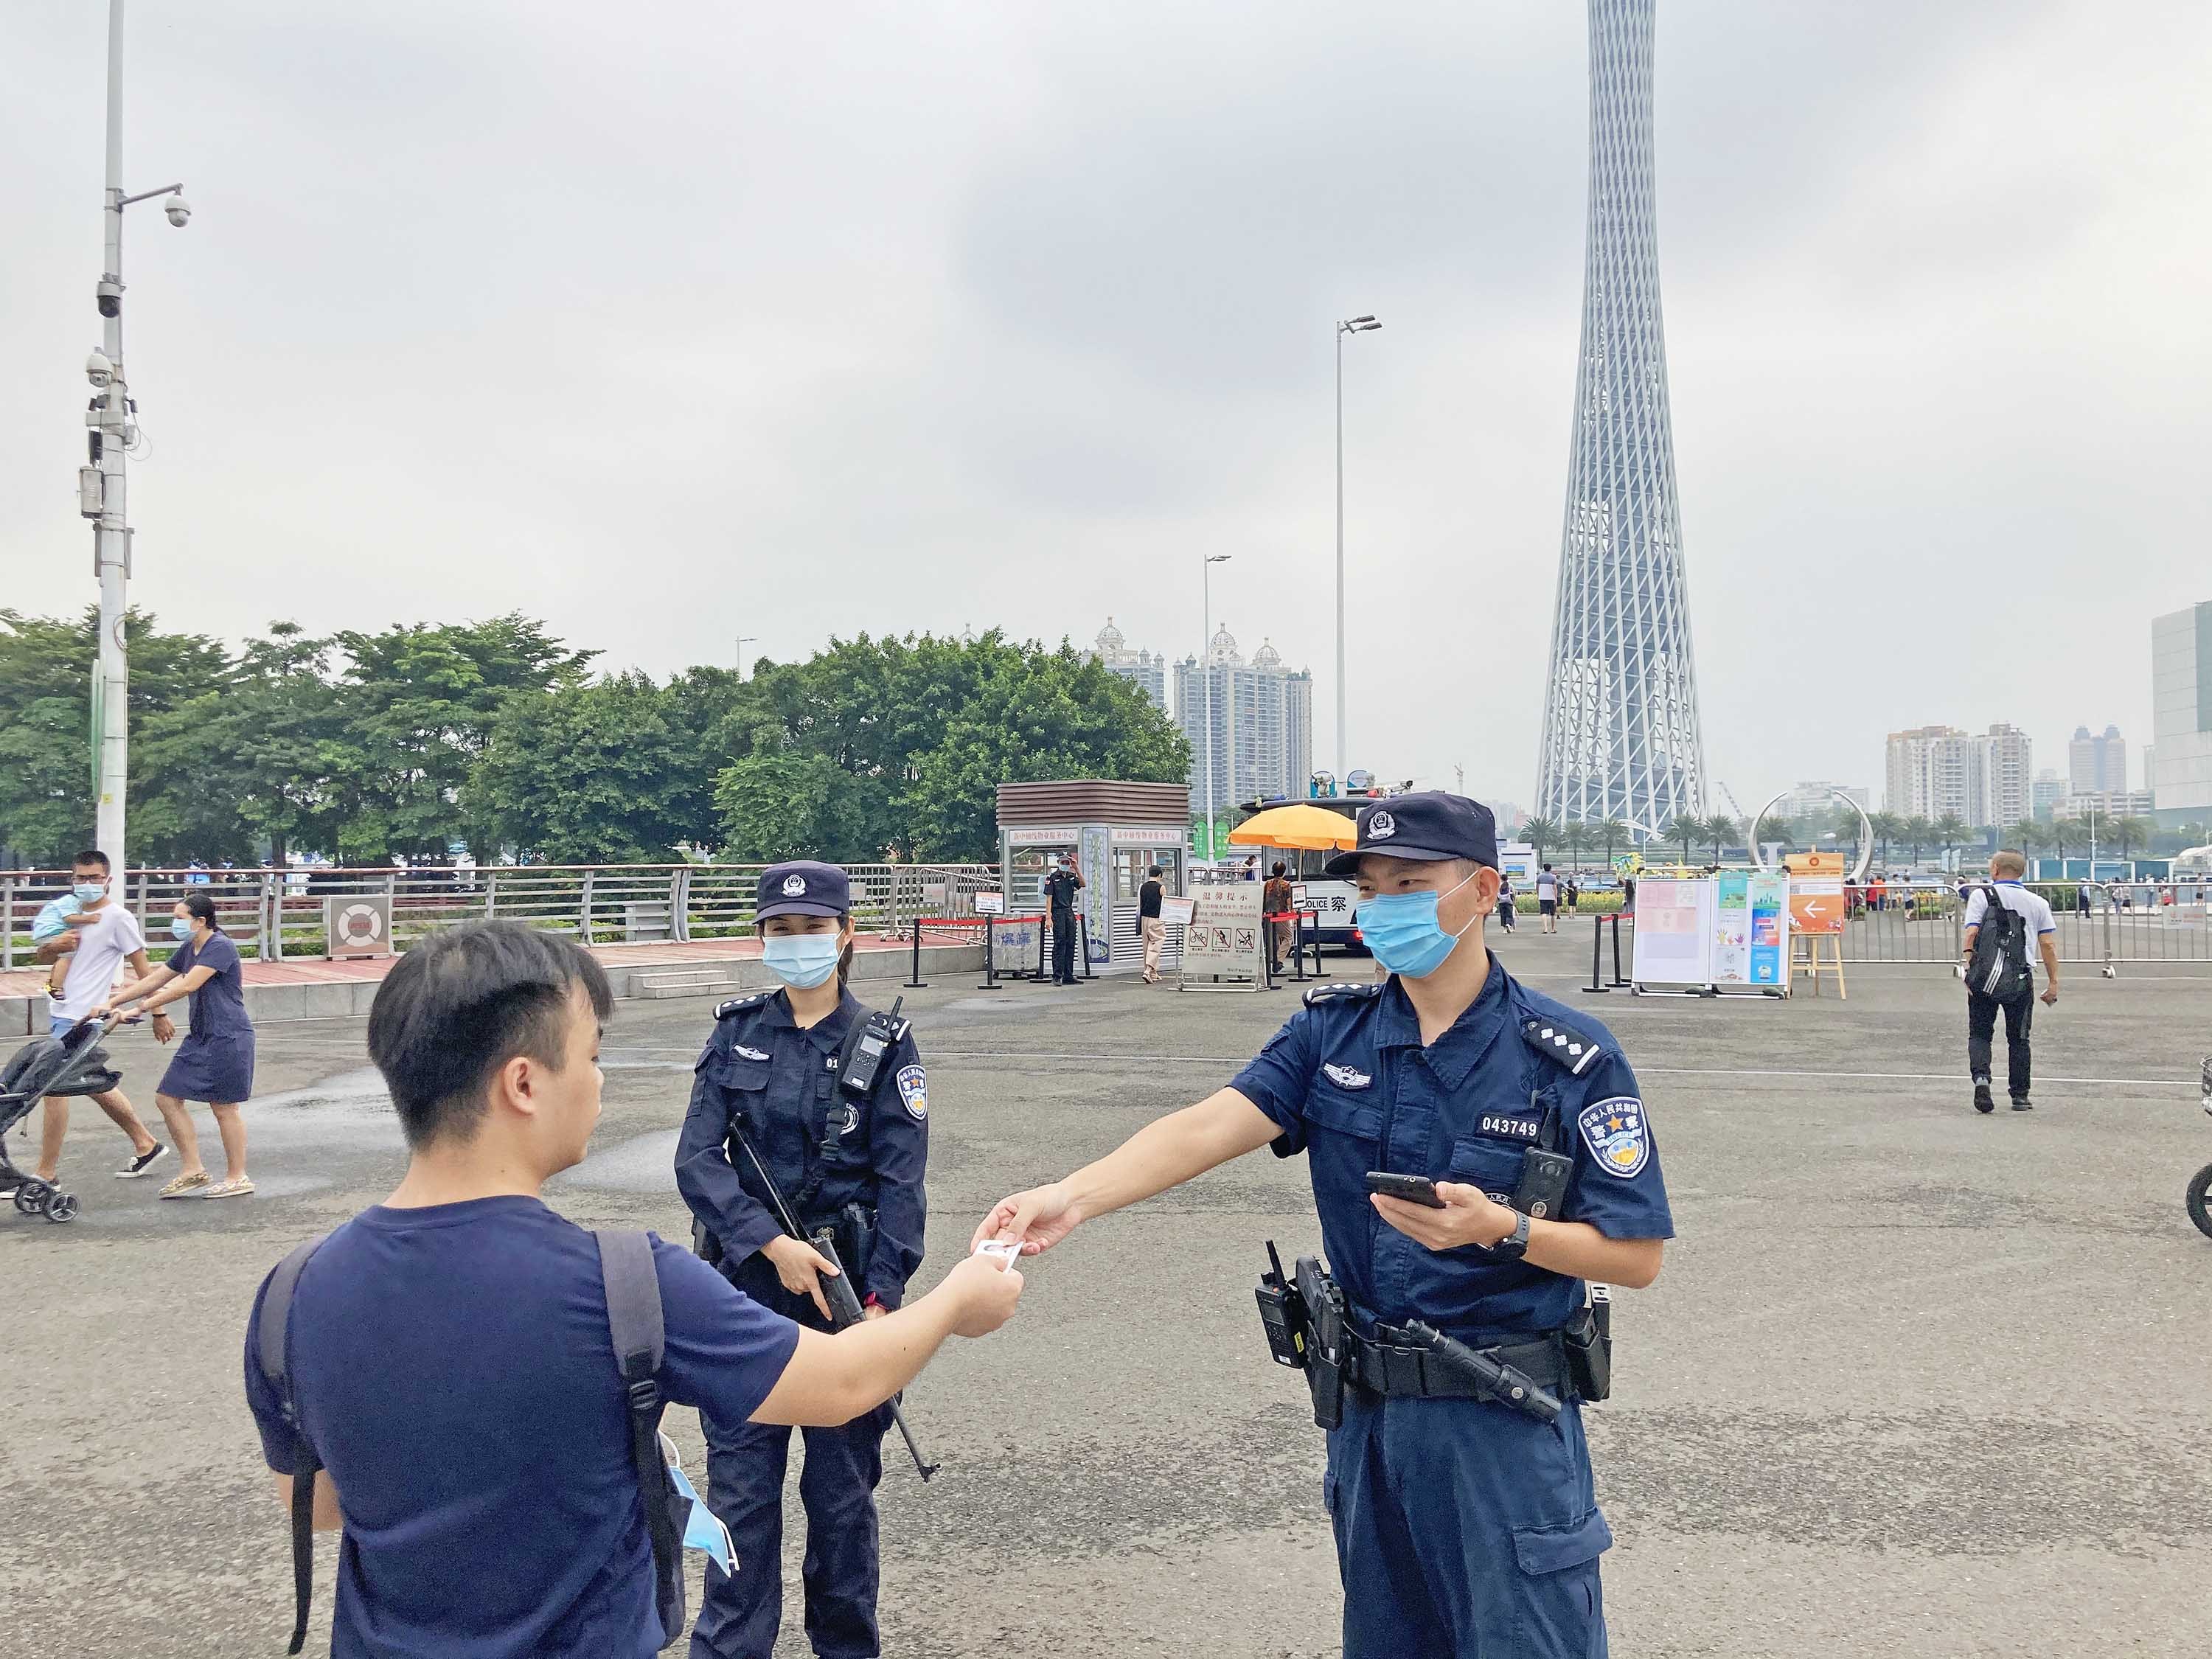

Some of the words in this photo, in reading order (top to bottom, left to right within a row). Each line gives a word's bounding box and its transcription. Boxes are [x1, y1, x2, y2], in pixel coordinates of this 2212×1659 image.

[1203, 891, 1248, 901] 温馨提示
[1331, 896, 1346, 911] 察
[1307, 900, 1328, 908] OLICE
[1582, 1102, 1638, 1128] 中华人民共和国
[1482, 1116, 1537, 1137] 043749
